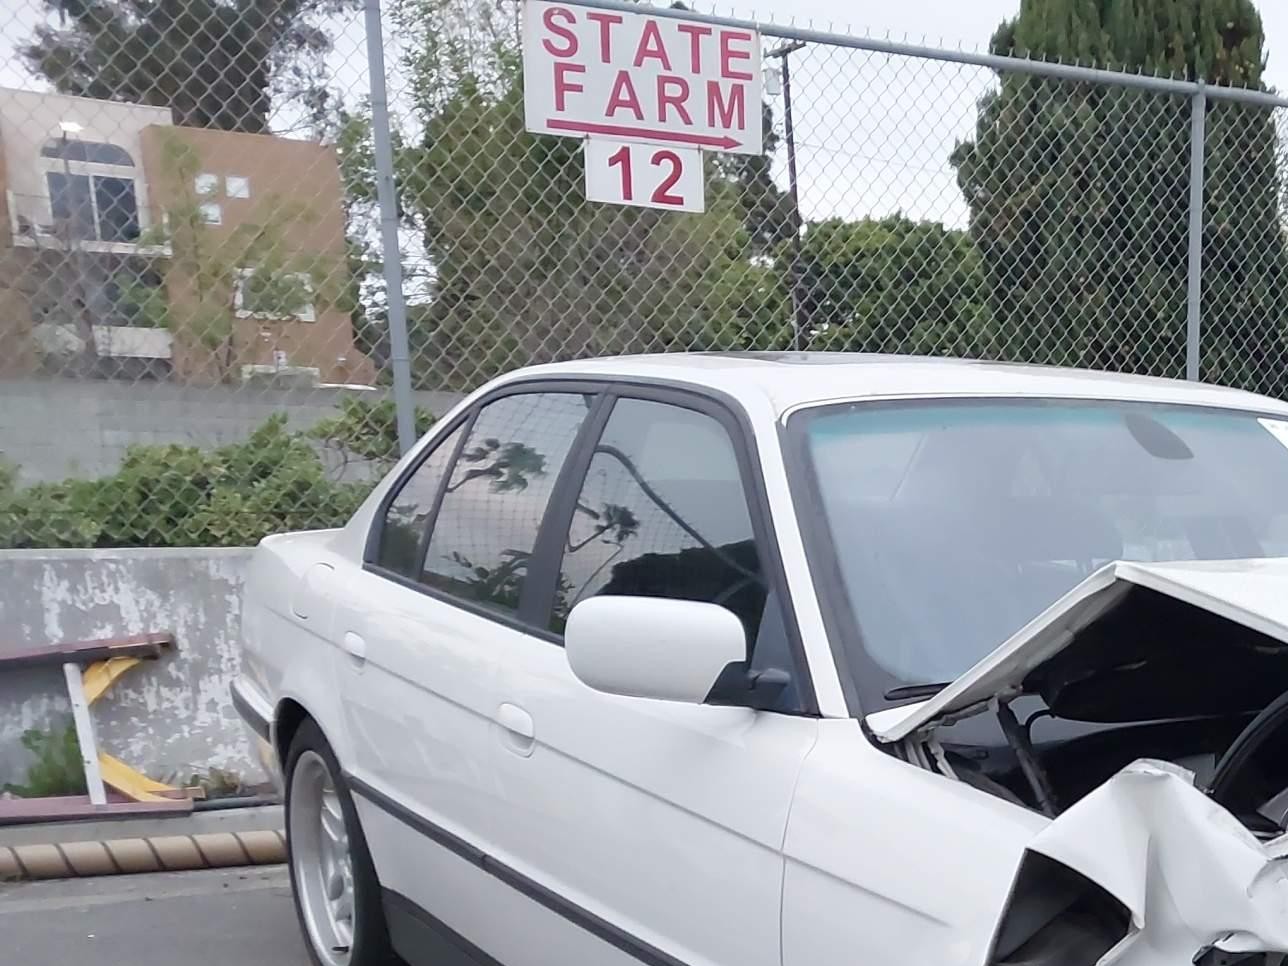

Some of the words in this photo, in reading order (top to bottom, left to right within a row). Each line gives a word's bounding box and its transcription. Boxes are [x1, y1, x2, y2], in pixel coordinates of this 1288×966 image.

[542, 7, 753, 81] STATE
[553, 62, 745, 130] FARM
[608, 146, 684, 205] 12
